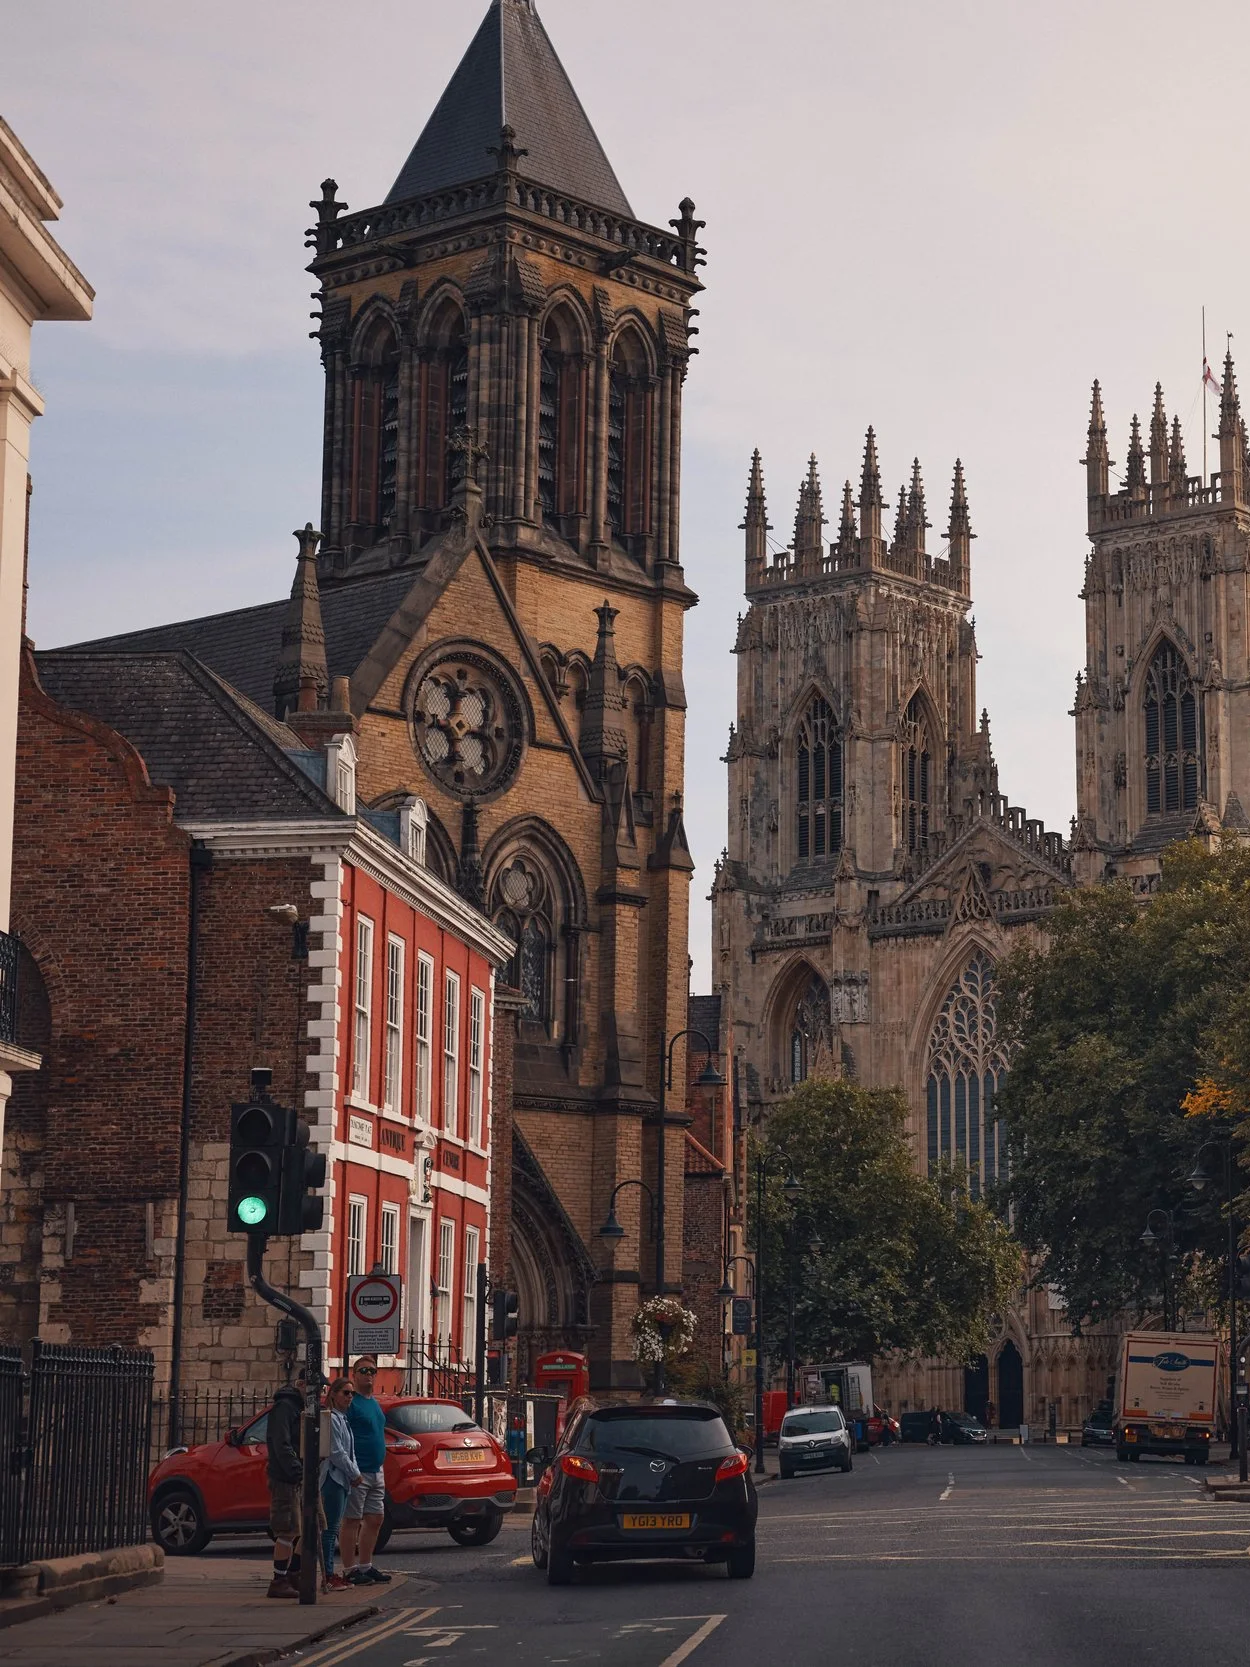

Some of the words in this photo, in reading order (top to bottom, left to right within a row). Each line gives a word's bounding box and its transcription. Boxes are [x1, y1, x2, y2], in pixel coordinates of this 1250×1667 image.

[380, 1127, 405, 1153] ANTIQUE
[631, 1516, 656, 1527] YG13
[660, 1515, 683, 1526] YRO
